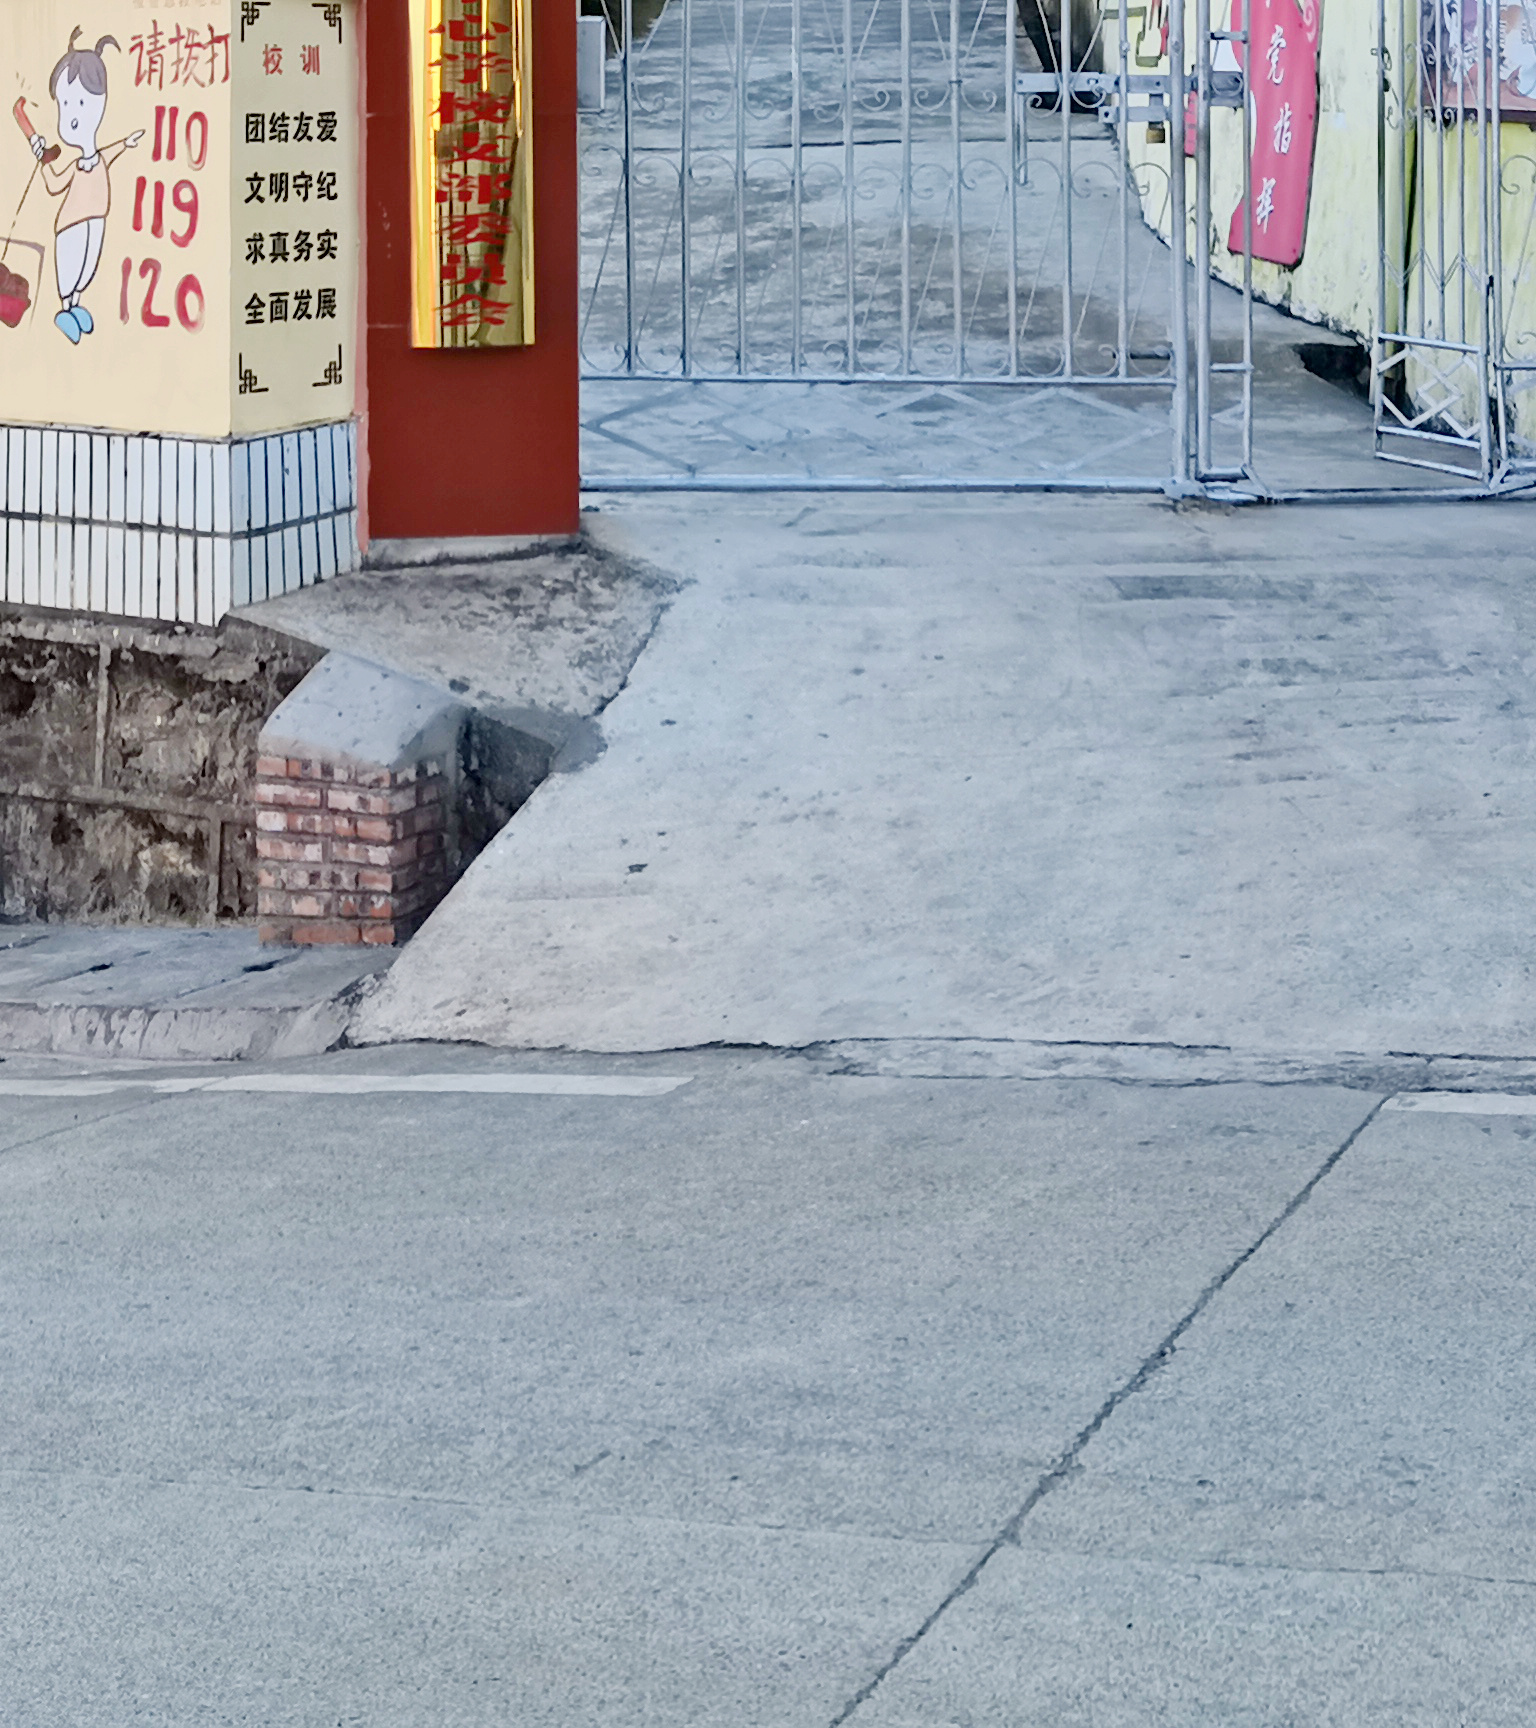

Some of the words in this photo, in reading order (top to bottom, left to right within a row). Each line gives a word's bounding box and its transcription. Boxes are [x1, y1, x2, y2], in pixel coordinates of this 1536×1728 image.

[129, 19, 231, 91] 请拨打
[262, 43, 322, 77] 校训
[152, 105, 208, 170] 110
[245, 110, 338, 145] 团结友爱
[244, 170, 338, 205] 文明守纪
[131, 175, 200, 248] 119
[244, 228, 338, 265] 求真务实
[118, 256, 206, 334] 120
[244, 287, 338, 326] 全面发展
